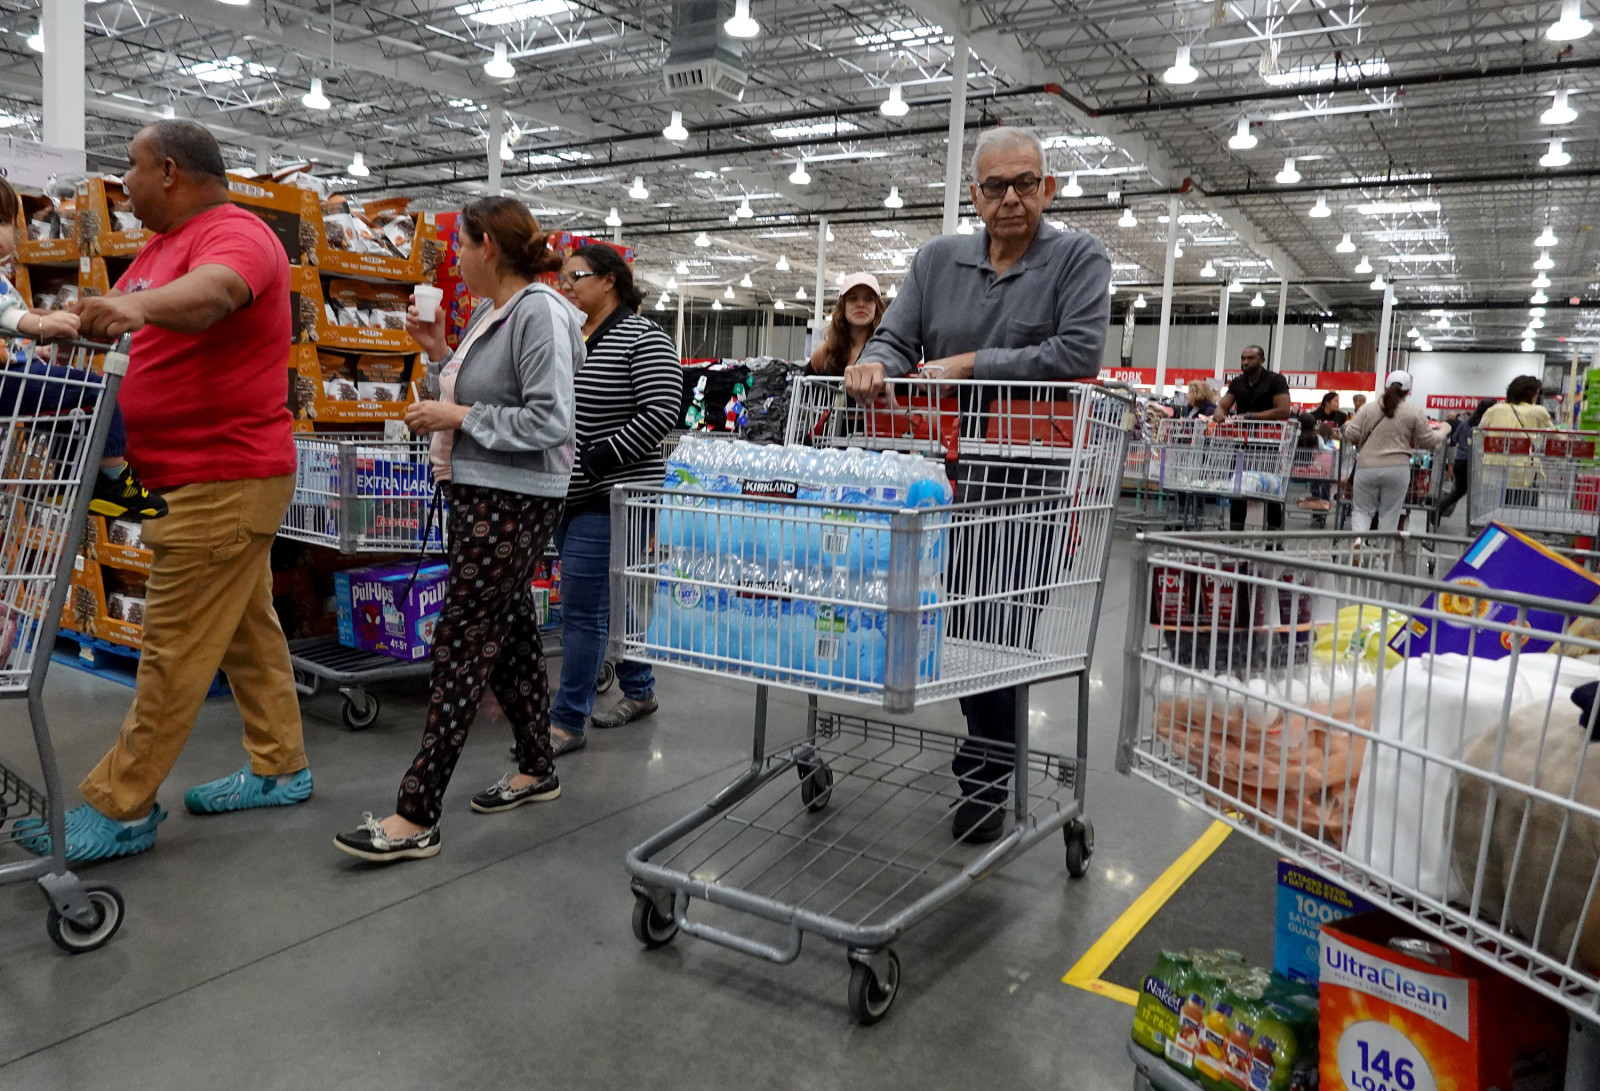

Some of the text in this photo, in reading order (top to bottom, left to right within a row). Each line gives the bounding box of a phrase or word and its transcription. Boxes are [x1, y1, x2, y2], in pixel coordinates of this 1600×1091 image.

[1115, 371, 1142, 383] PORK
[1431, 397, 1462, 408] FRESH
[357, 474, 444, 499] EXTRA LARG
[744, 480, 797, 494] KIRKLAND
[419, 580, 445, 617] Pull
[1288, 870, 1346, 899] ATTACKS EVEN
[1288, 876, 1304, 889] DAY
[1305, 881, 1322, 896] OLD
[1326, 946, 1448, 1011] UltraClean
[1146, 978, 1181, 1013] Naked
[1142, 1007, 1175, 1038] 12-PACK
[1357, 1040, 1416, 1091] 146
